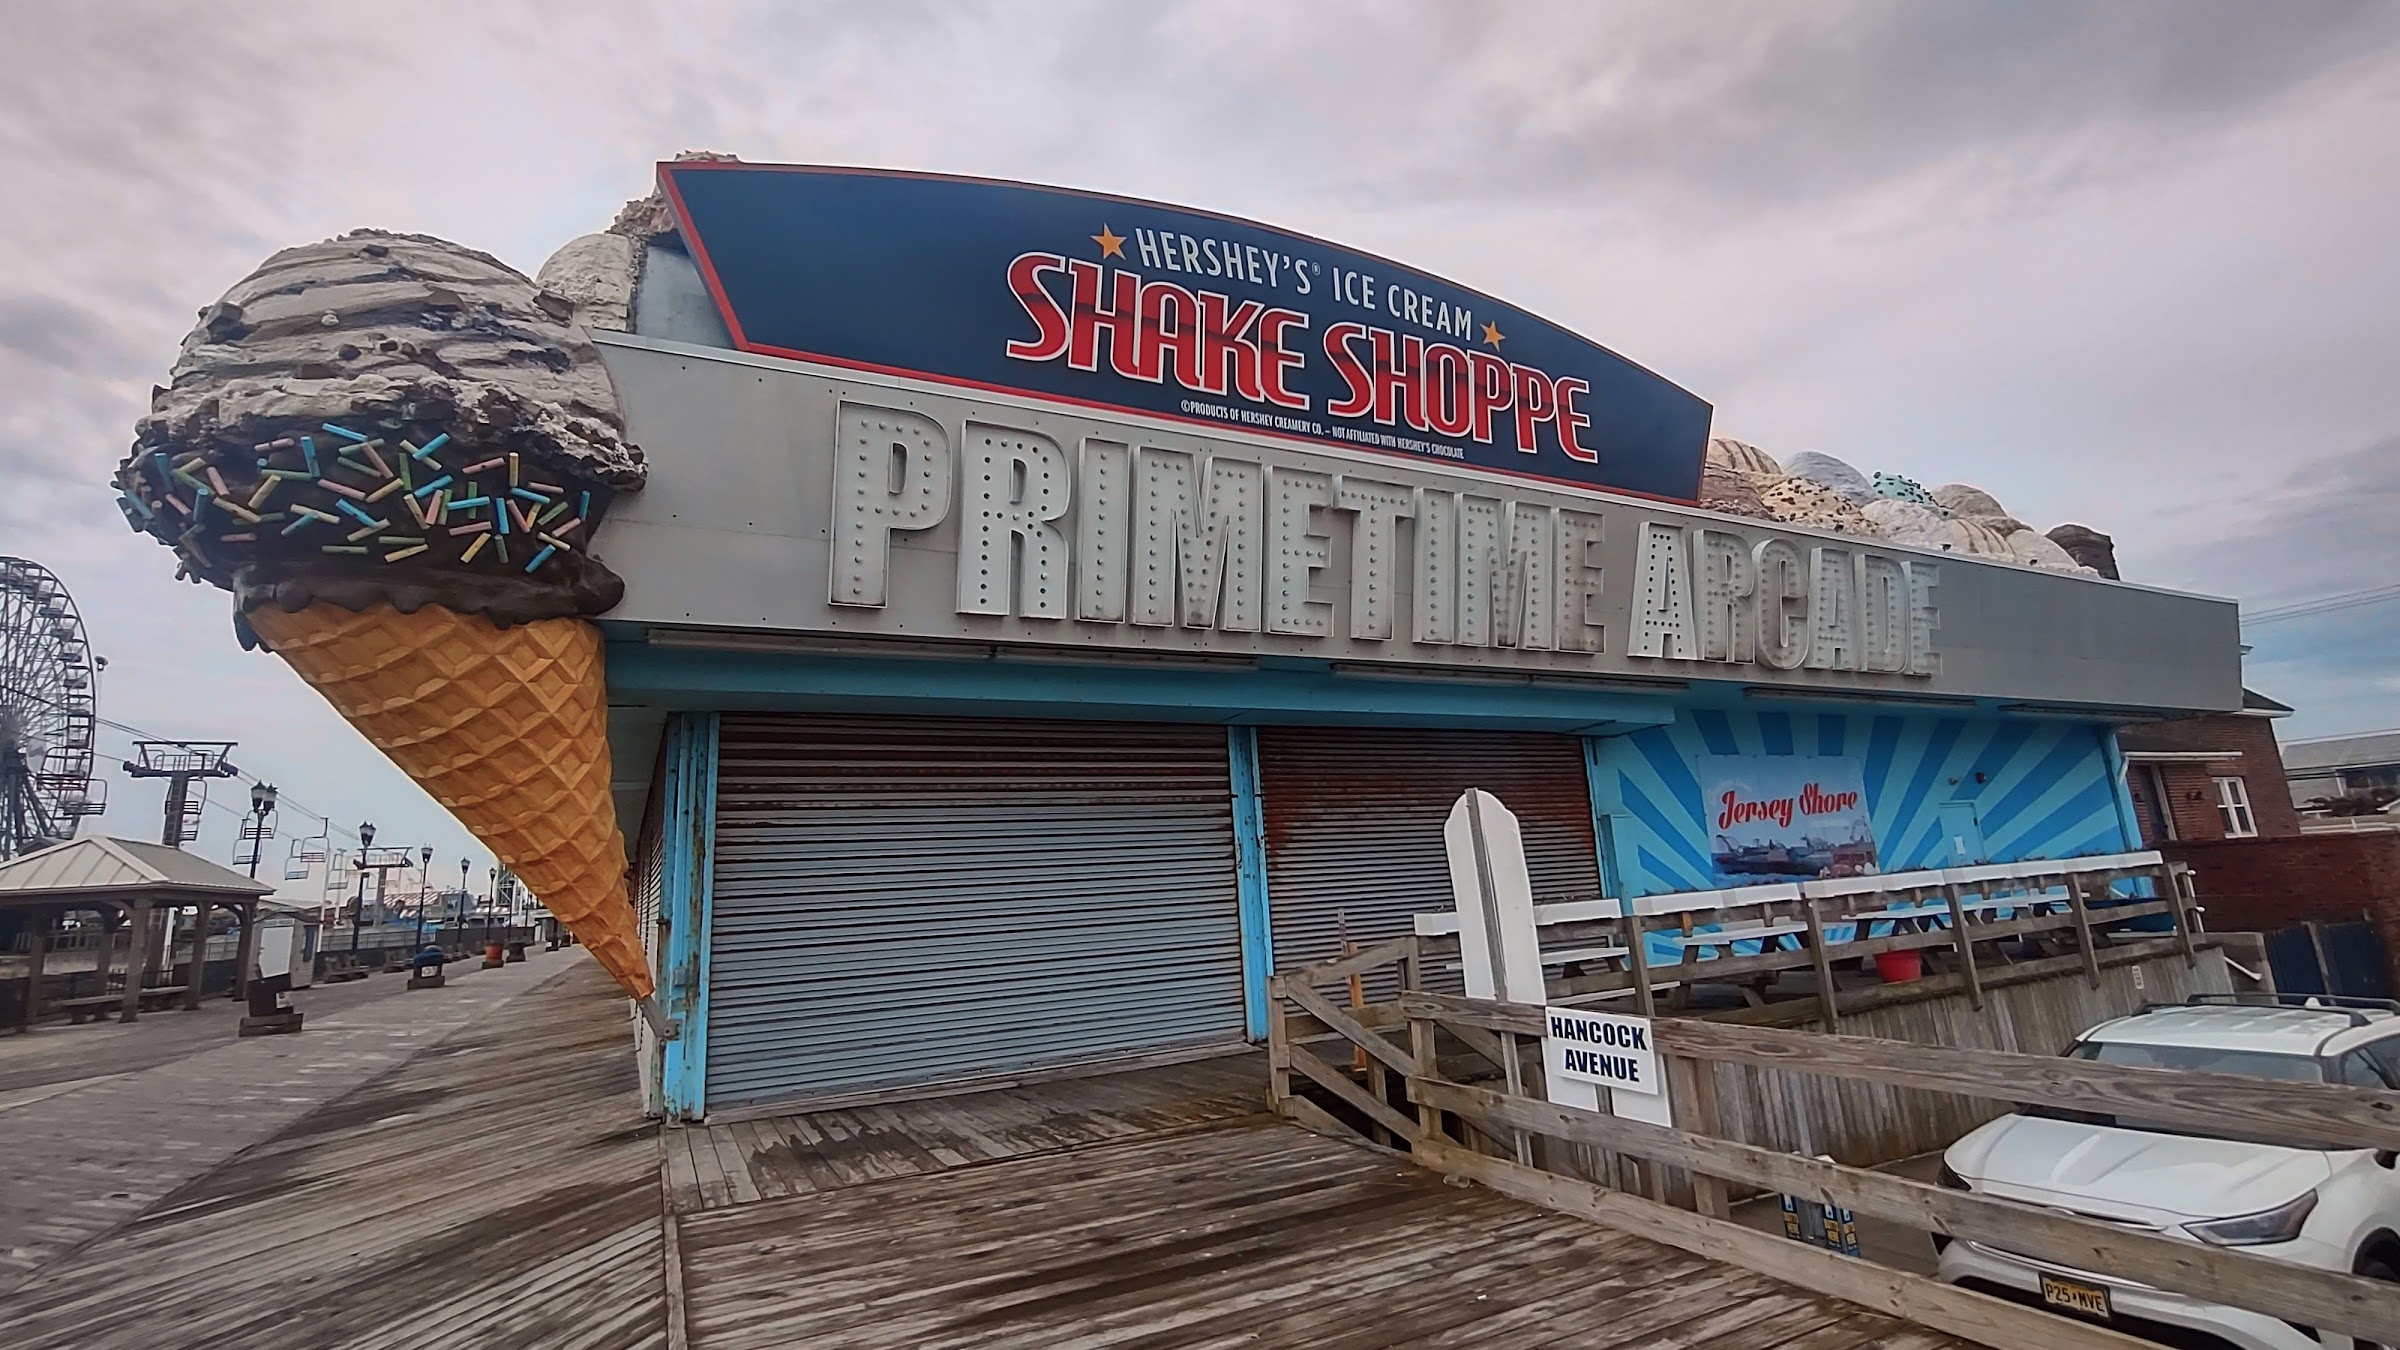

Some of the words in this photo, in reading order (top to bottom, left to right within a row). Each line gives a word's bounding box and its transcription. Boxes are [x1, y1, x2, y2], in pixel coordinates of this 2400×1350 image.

[1332, 267, 1376, 310] ICE
[1387, 285, 1472, 341] CREAM
[1005, 251, 1310, 410] SHAKE
[1323, 320, 1598, 464] SHOPPE
[1229, 408, 1240, 421] OF
[1240, 410, 1273, 427] HERSHEY
[1274, 416, 1311, 433] CREAMERY
[1312, 423, 1324, 436] CO.
[1332, 426, 1346, 439] NOT
[1345, 429, 1380, 445] AFFILIATED
[1380, 434, 1396, 448] WITH
[1397, 437, 1431, 454] HERSHEY'S
[1431, 443, 1465, 459] CHOCOLATE
[828, 400, 1606, 654] PRIMETIME
[1627, 521, 1943, 677] ARCADE
[1718, 789, 1795, 830] Jersey
[1798, 782, 1858, 816] Shore
[1550, 1016, 1648, 1051] HANCOCK
[1564, 1048, 1640, 1082] AVENUE
